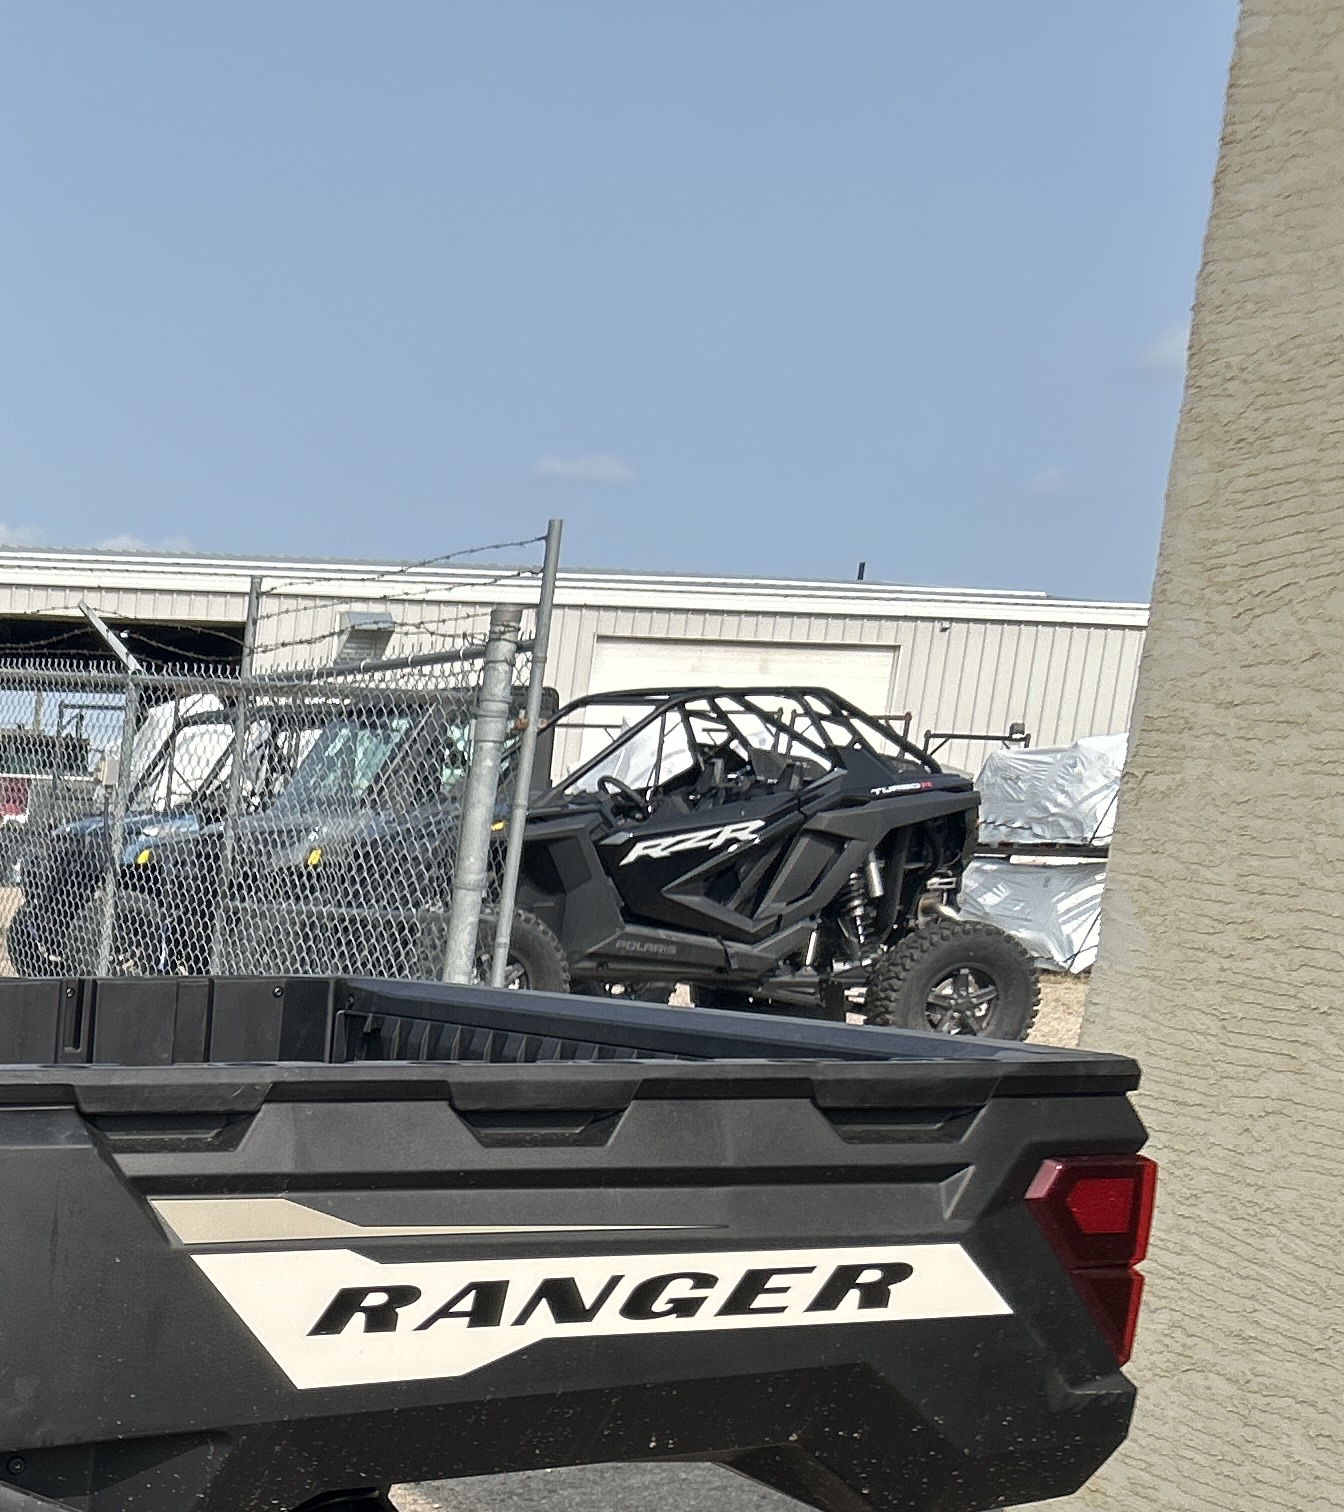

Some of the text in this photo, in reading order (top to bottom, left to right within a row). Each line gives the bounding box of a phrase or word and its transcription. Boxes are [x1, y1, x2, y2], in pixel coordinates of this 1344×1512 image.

[618, 819, 765, 866] RZR
[615, 940, 677, 955] POLARIS
[305, 1262, 914, 1337] RANGER
